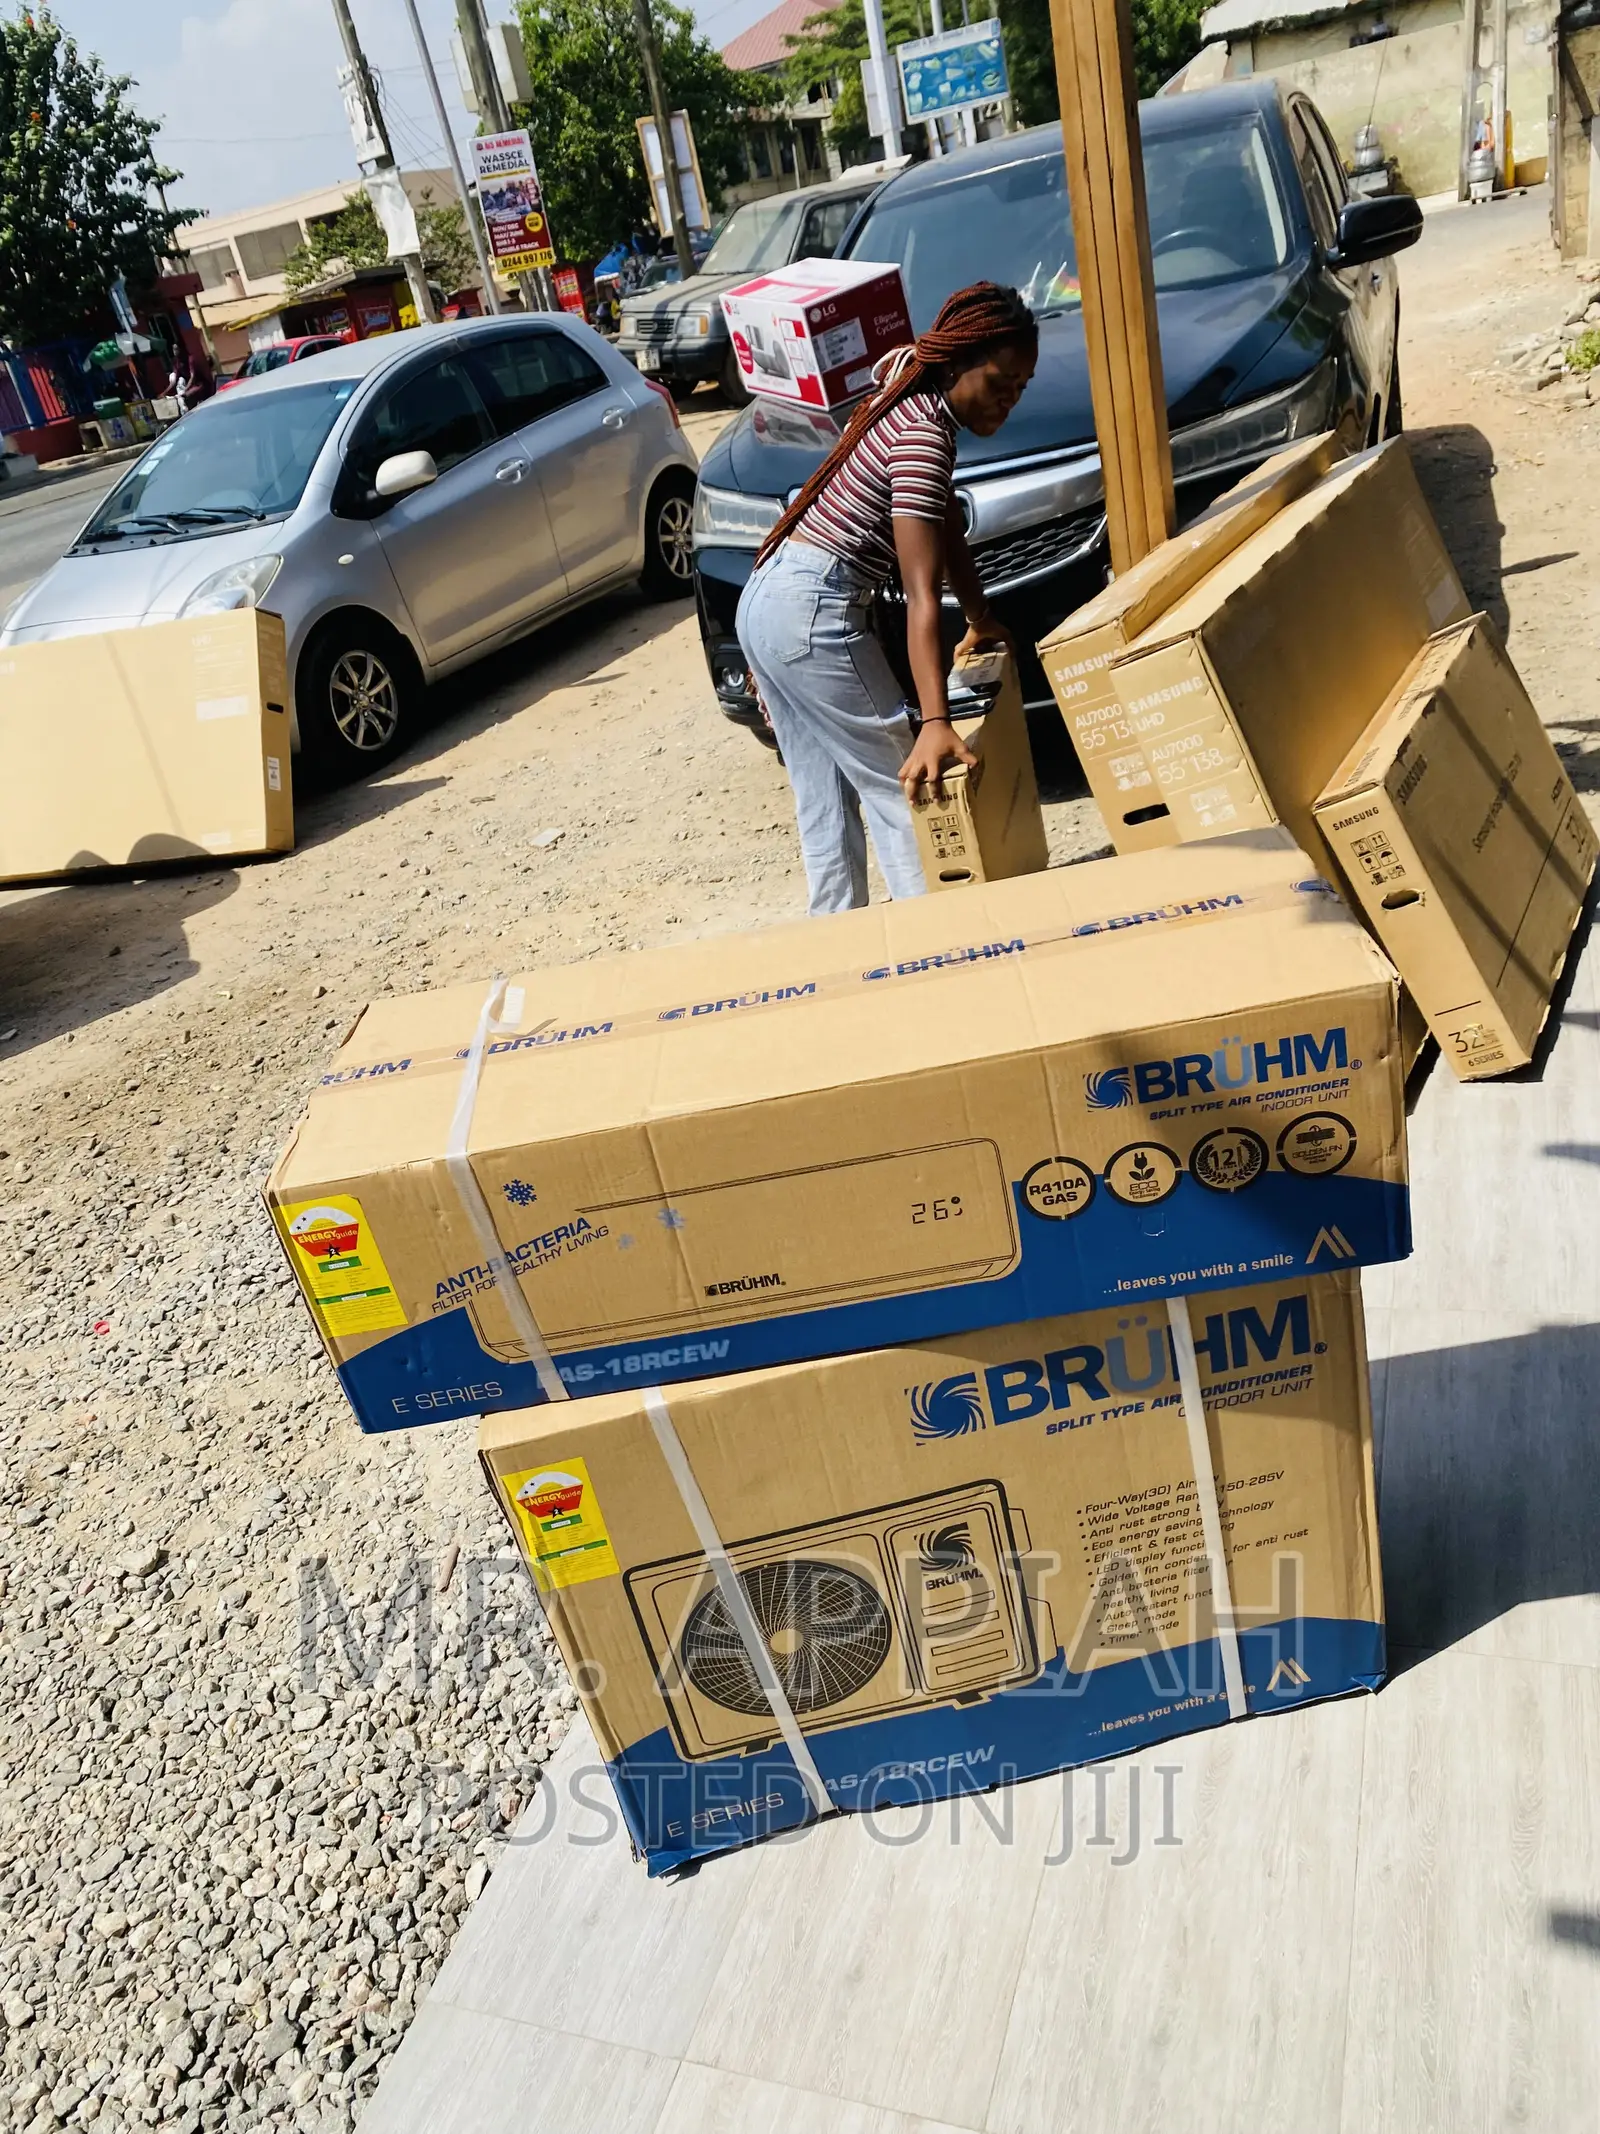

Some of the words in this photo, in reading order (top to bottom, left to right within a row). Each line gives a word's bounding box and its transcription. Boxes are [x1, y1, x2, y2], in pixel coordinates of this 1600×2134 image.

[480, 159, 531, 174] REMEDIAL
[482, 150, 524, 164] WASSCE
[502, 257, 522, 268] 0244
[523, 253, 538, 264] 997
[540, 250, 553, 261] 176
[822, 303, 837, 316] LG
[876, 319, 906, 336] Cyclone
[1060, 681, 1089, 699] UHD
[1128, 676, 1204, 715] SAMSUNG
[1075, 703, 1123, 729] AU7000
[1136, 712, 1165, 733] UHD
[1152, 734, 1204, 762] AU7000
[1332, 806, 1380, 831] SAMSUNG
[319, 1057, 412, 1087] RÜHM
[488, 1022, 613, 1055] BRÜHM
[691, 981, 817, 1017] BRÜHM
[896, 938, 1027, 976] BRÜHM
[1107, 893, 1244, 930] BRÜHM
[1133, 1027, 1349, 1104] BRÜHM
[1150, 1107, 1185, 1121] SPLIT
[1191, 1100, 1224, 1114] TYPE
[1228, 1096, 1252, 1108] AIR
[1256, 1078, 1350, 1102] CONDITIONER
[1261, 1095, 1313, 1113] INDOOR
[1318, 1088, 1350, 1104] UNIT
[1029, 1178, 1087, 1197] R410A
[1042, 1190, 1079, 1206] GAS
[1129, 1180, 1159, 1192] ECO
[298, 1230, 337, 1243] ENERGY
[335, 1229, 358, 1240] guide
[431, 1292, 473, 1314] FILTER
[514, 1246, 562, 1276] EALTHY
[566, 1225, 609, 1252] LIVING
[1169, 1271, 1198, 1288] you
[1200, 1261, 1234, 1279] with
[1238, 1262, 1248, 1272] a
[1251, 1252, 1294, 1270] smile
[719, 1273, 781, 1296] BRÜHM
[537, 1339, 731, 1389] AS-18RCEW
[392, 1396, 411, 1414] E
[415, 1381, 503, 1410] SERIES
[1045, 1414, 1096, 1436] SPLIT
[1100, 1403, 1148, 1422] TYPE
[1151, 1394, 1182, 1411] AIR
[1200, 1363, 1313, 1398] ONDITIONER
[1178, 1391, 1264, 1418] OTDOOR
[1270, 1377, 1315, 1399] UNIT
[525, 1492, 562, 1506] ENERGY
[561, 1490, 582, 1500] guide
[1085, 1484, 1171, 1514] Four-Way(3D)
[1088, 1512, 1119, 1526] Wide
[1125, 1499, 1170, 1516] Voltage
[1090, 1525, 1115, 1539] Anti
[1120, 1518, 1145, 1531] rust
[1150, 1507, 1190, 1523] strong
[1092, 1540, 1113, 1551] Eco
[1119, 1527, 1160, 1544] energy
[1165, 1517, 1203, 1533] saving
[1094, 1544, 1143, 1563] Efficient
[1148, 1539, 1158, 1549] &
[1163, 1532, 1188, 1545] fast
[1096, 1561, 1120, 1575] LED
[1125, 1551, 1166, 1568] display
[1171, 1540, 1205, 1555] functi
[1098, 1570, 1139, 1587] Golden
[1144, 1565, 1159, 1576] fin
[1232, 1543, 1250, 1553] for
[1255, 1534, 1279, 1548] anti
[1283, 1528, 1309, 1541] rust
[1183, 1564, 1210, 1578] filter
[1103, 1594, 1145, 1610] healthy
[1150, 1585, 1180, 1598] living
[1106, 1620, 1138, 1634] Sleep
[1144, 1610, 1176, 1624] mode
[1109, 1630, 1142, 1645] Timer
[1147, 1620, 1180, 1634] mode
[1148, 1705, 1171, 1721] you
[1174, 1696, 1204, 1711] with
[1207, 1694, 1216, 1703] a
[801, 1745, 996, 1798] AS-18RCEW
[667, 1821, 685, 1839] E
[691, 1792, 784, 1830] SERIES
